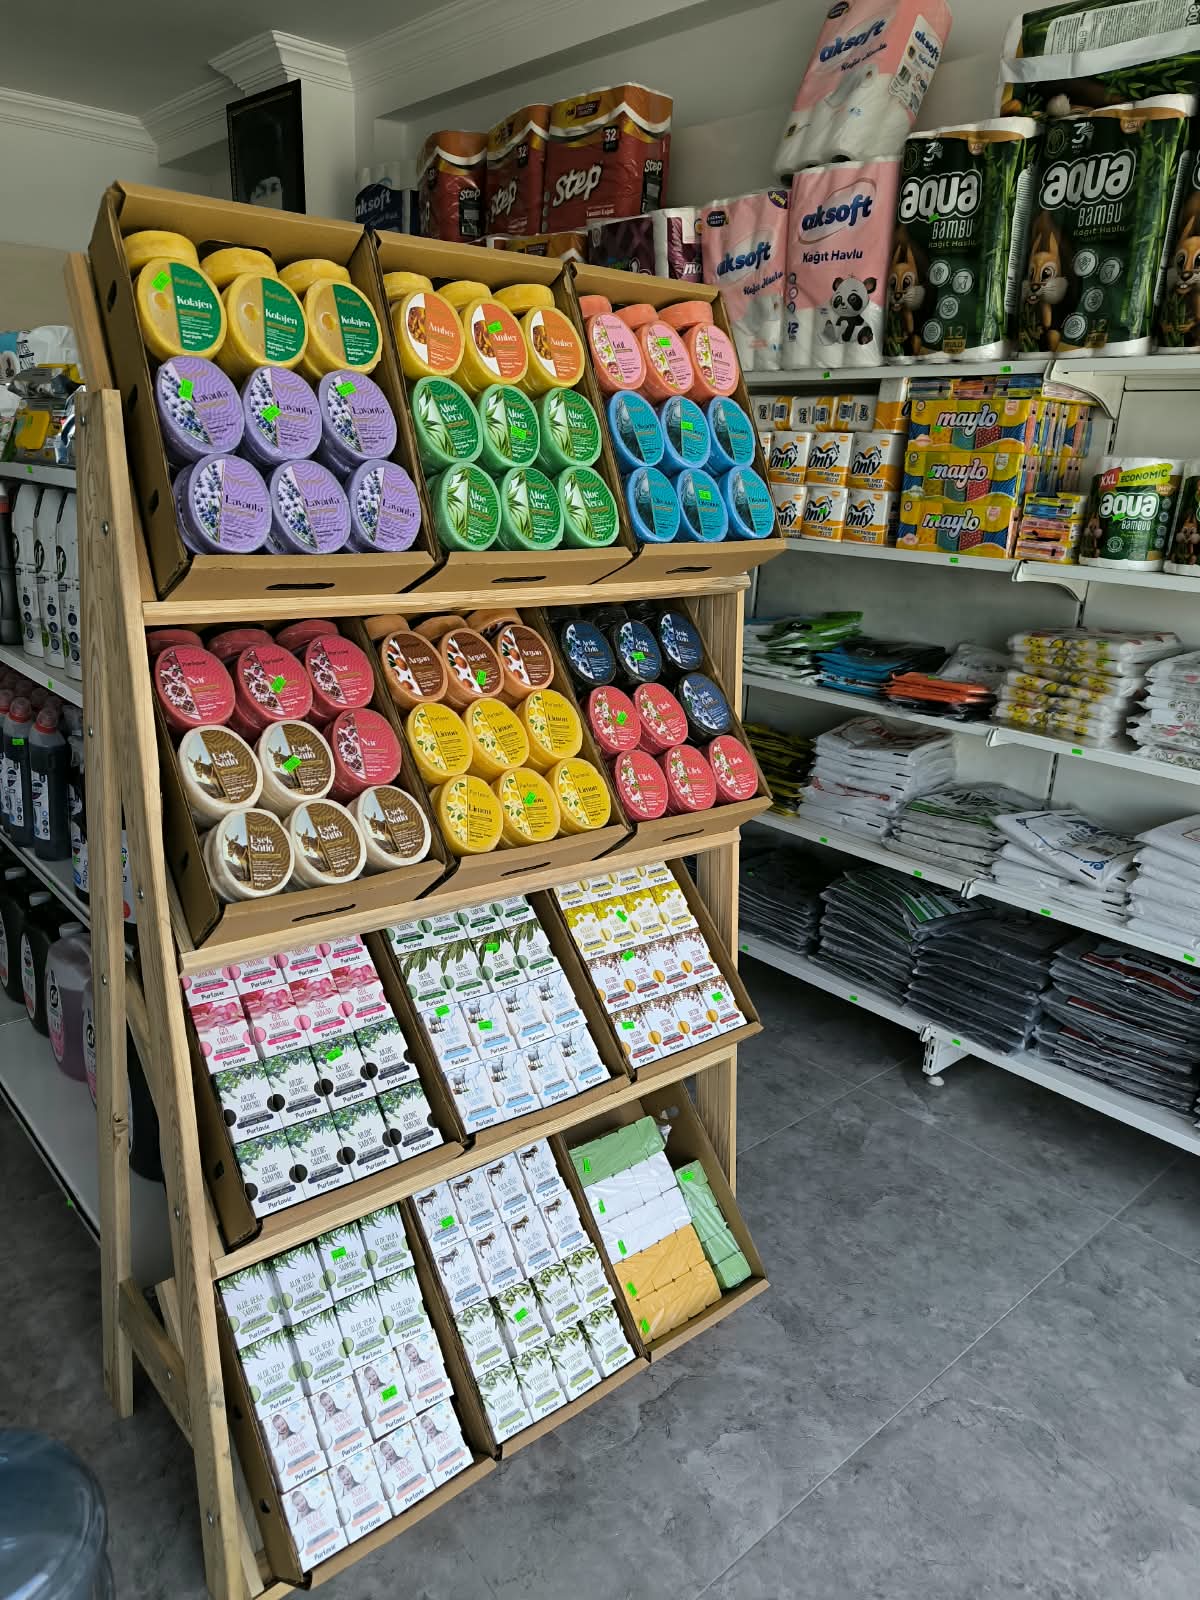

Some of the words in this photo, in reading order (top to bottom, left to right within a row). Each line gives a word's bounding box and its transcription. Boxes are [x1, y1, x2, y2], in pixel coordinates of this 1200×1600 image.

[820, 19, 887, 62] aksoft
[605, 128, 616, 142] 32
[644, 159, 662, 175] Step
[552, 163, 603, 207] Step
[460, 188, 480, 200] Step
[801, 193, 873, 231] aksoft
[717, 241, 772, 276] aksoft
[802, 251, 828, 264] Kağıt
[831, 249, 863, 261] Havlu
[176, 295, 213, 310] Kolajen
[264, 308, 298, 326] Kolajen
[340, 314, 371, 328] Kolajen
[440, 403, 457, 414] Aloe
[507, 409, 525, 420] Aloe
[567, 409, 584, 420] Aloe
[936, 404, 998, 436] maylo
[770, 454, 797, 469] Only
[808, 453, 839, 469] Only
[852, 460, 881, 475] Only
[931, 458, 988, 489] maylo
[1100, 474, 1117, 487] XXL
[1121, 469, 1168, 482] ECONOMIC
[778, 513, 797, 527] nly
[846, 513, 874, 528] Only
[922, 508, 981, 537] maylo
[522, 648, 543, 657] Argan
